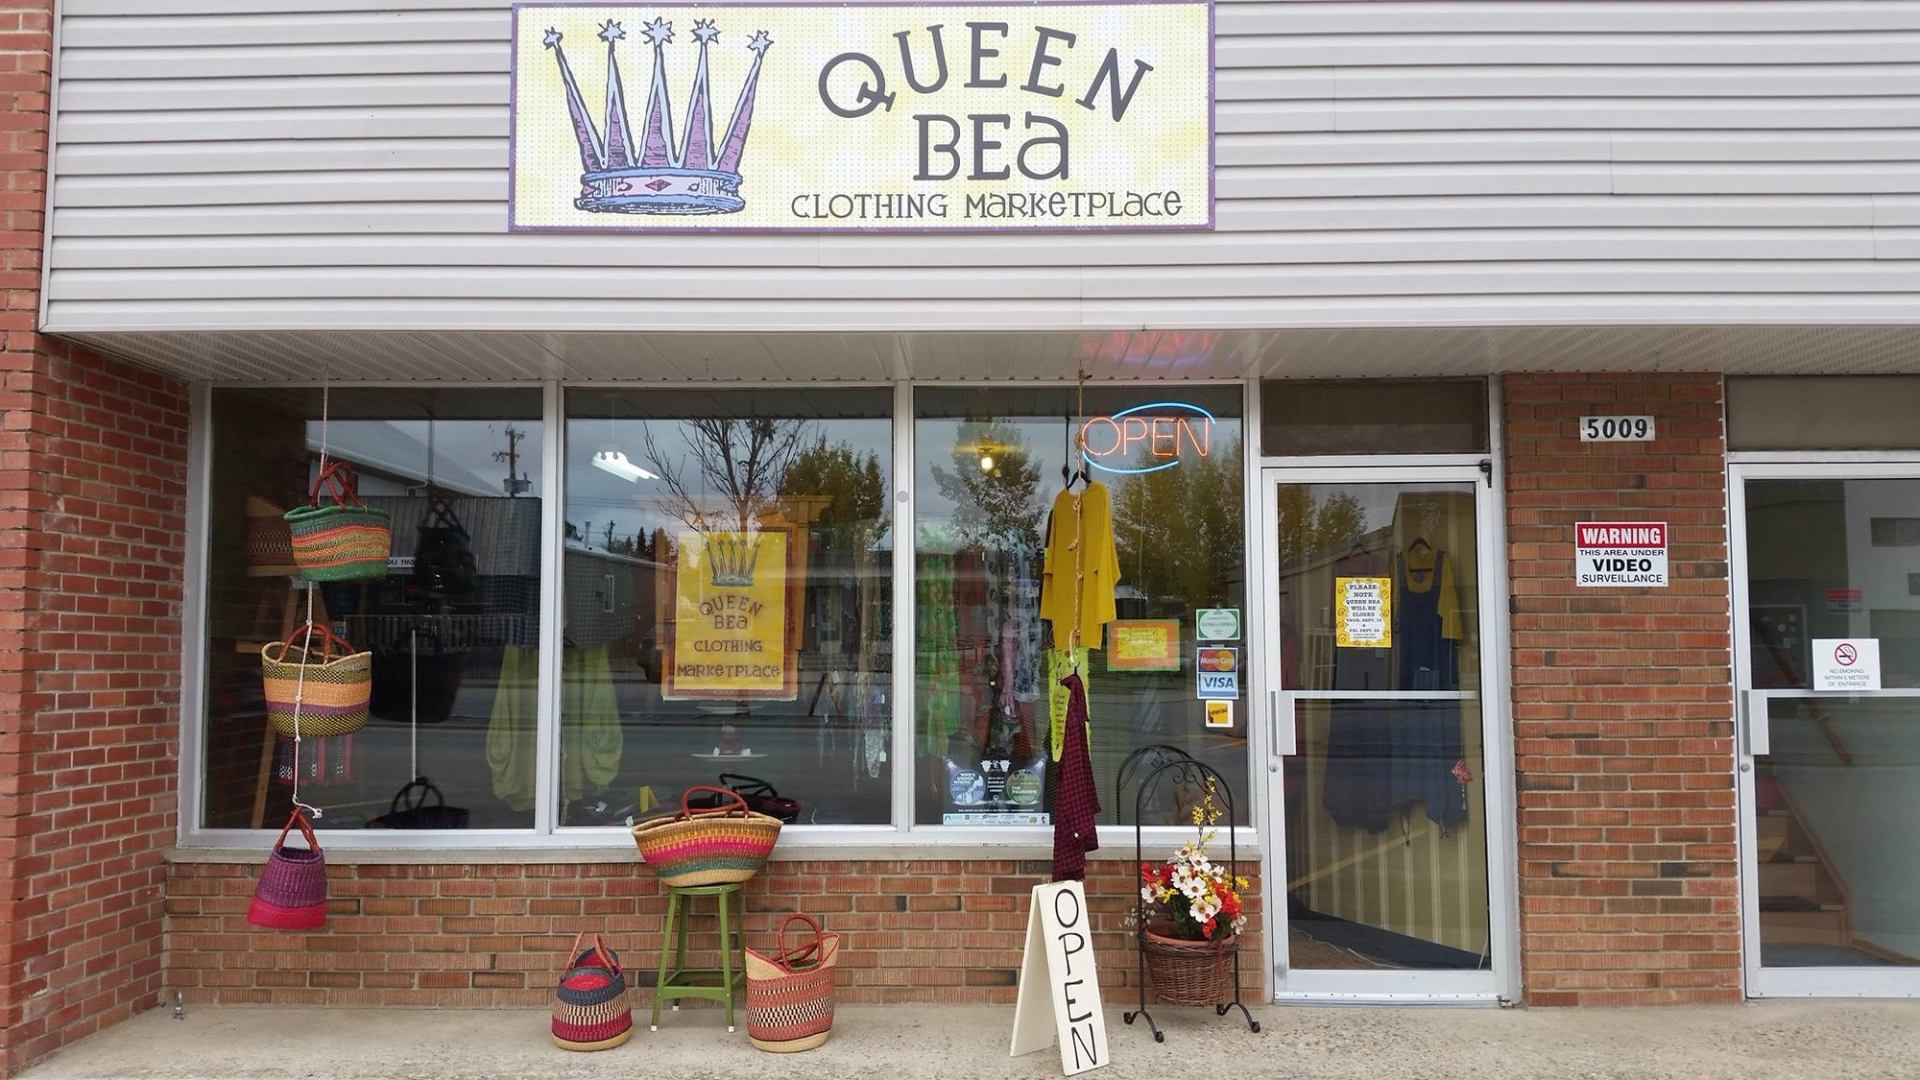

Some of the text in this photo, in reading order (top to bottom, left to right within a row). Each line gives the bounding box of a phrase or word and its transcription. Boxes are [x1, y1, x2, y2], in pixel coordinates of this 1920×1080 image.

[818, 21, 1154, 122] QUEEN
[791, 193, 948, 219] CLOTHING
[1082, 417, 1209, 457] OPEN
[1587, 418, 1648, 439] 5009
[1582, 527, 1661, 545] WARNING
[1592, 559, 1652, 572] VIDEO
[1581, 574, 1663, 583] SURVEILLANCE
[699, 594, 765, 616] QUEEN
[694, 640, 763, 652] CLOTHING
[1203, 676, 1235, 688] VISA
[1055, 888, 1098, 1070] OPEN
